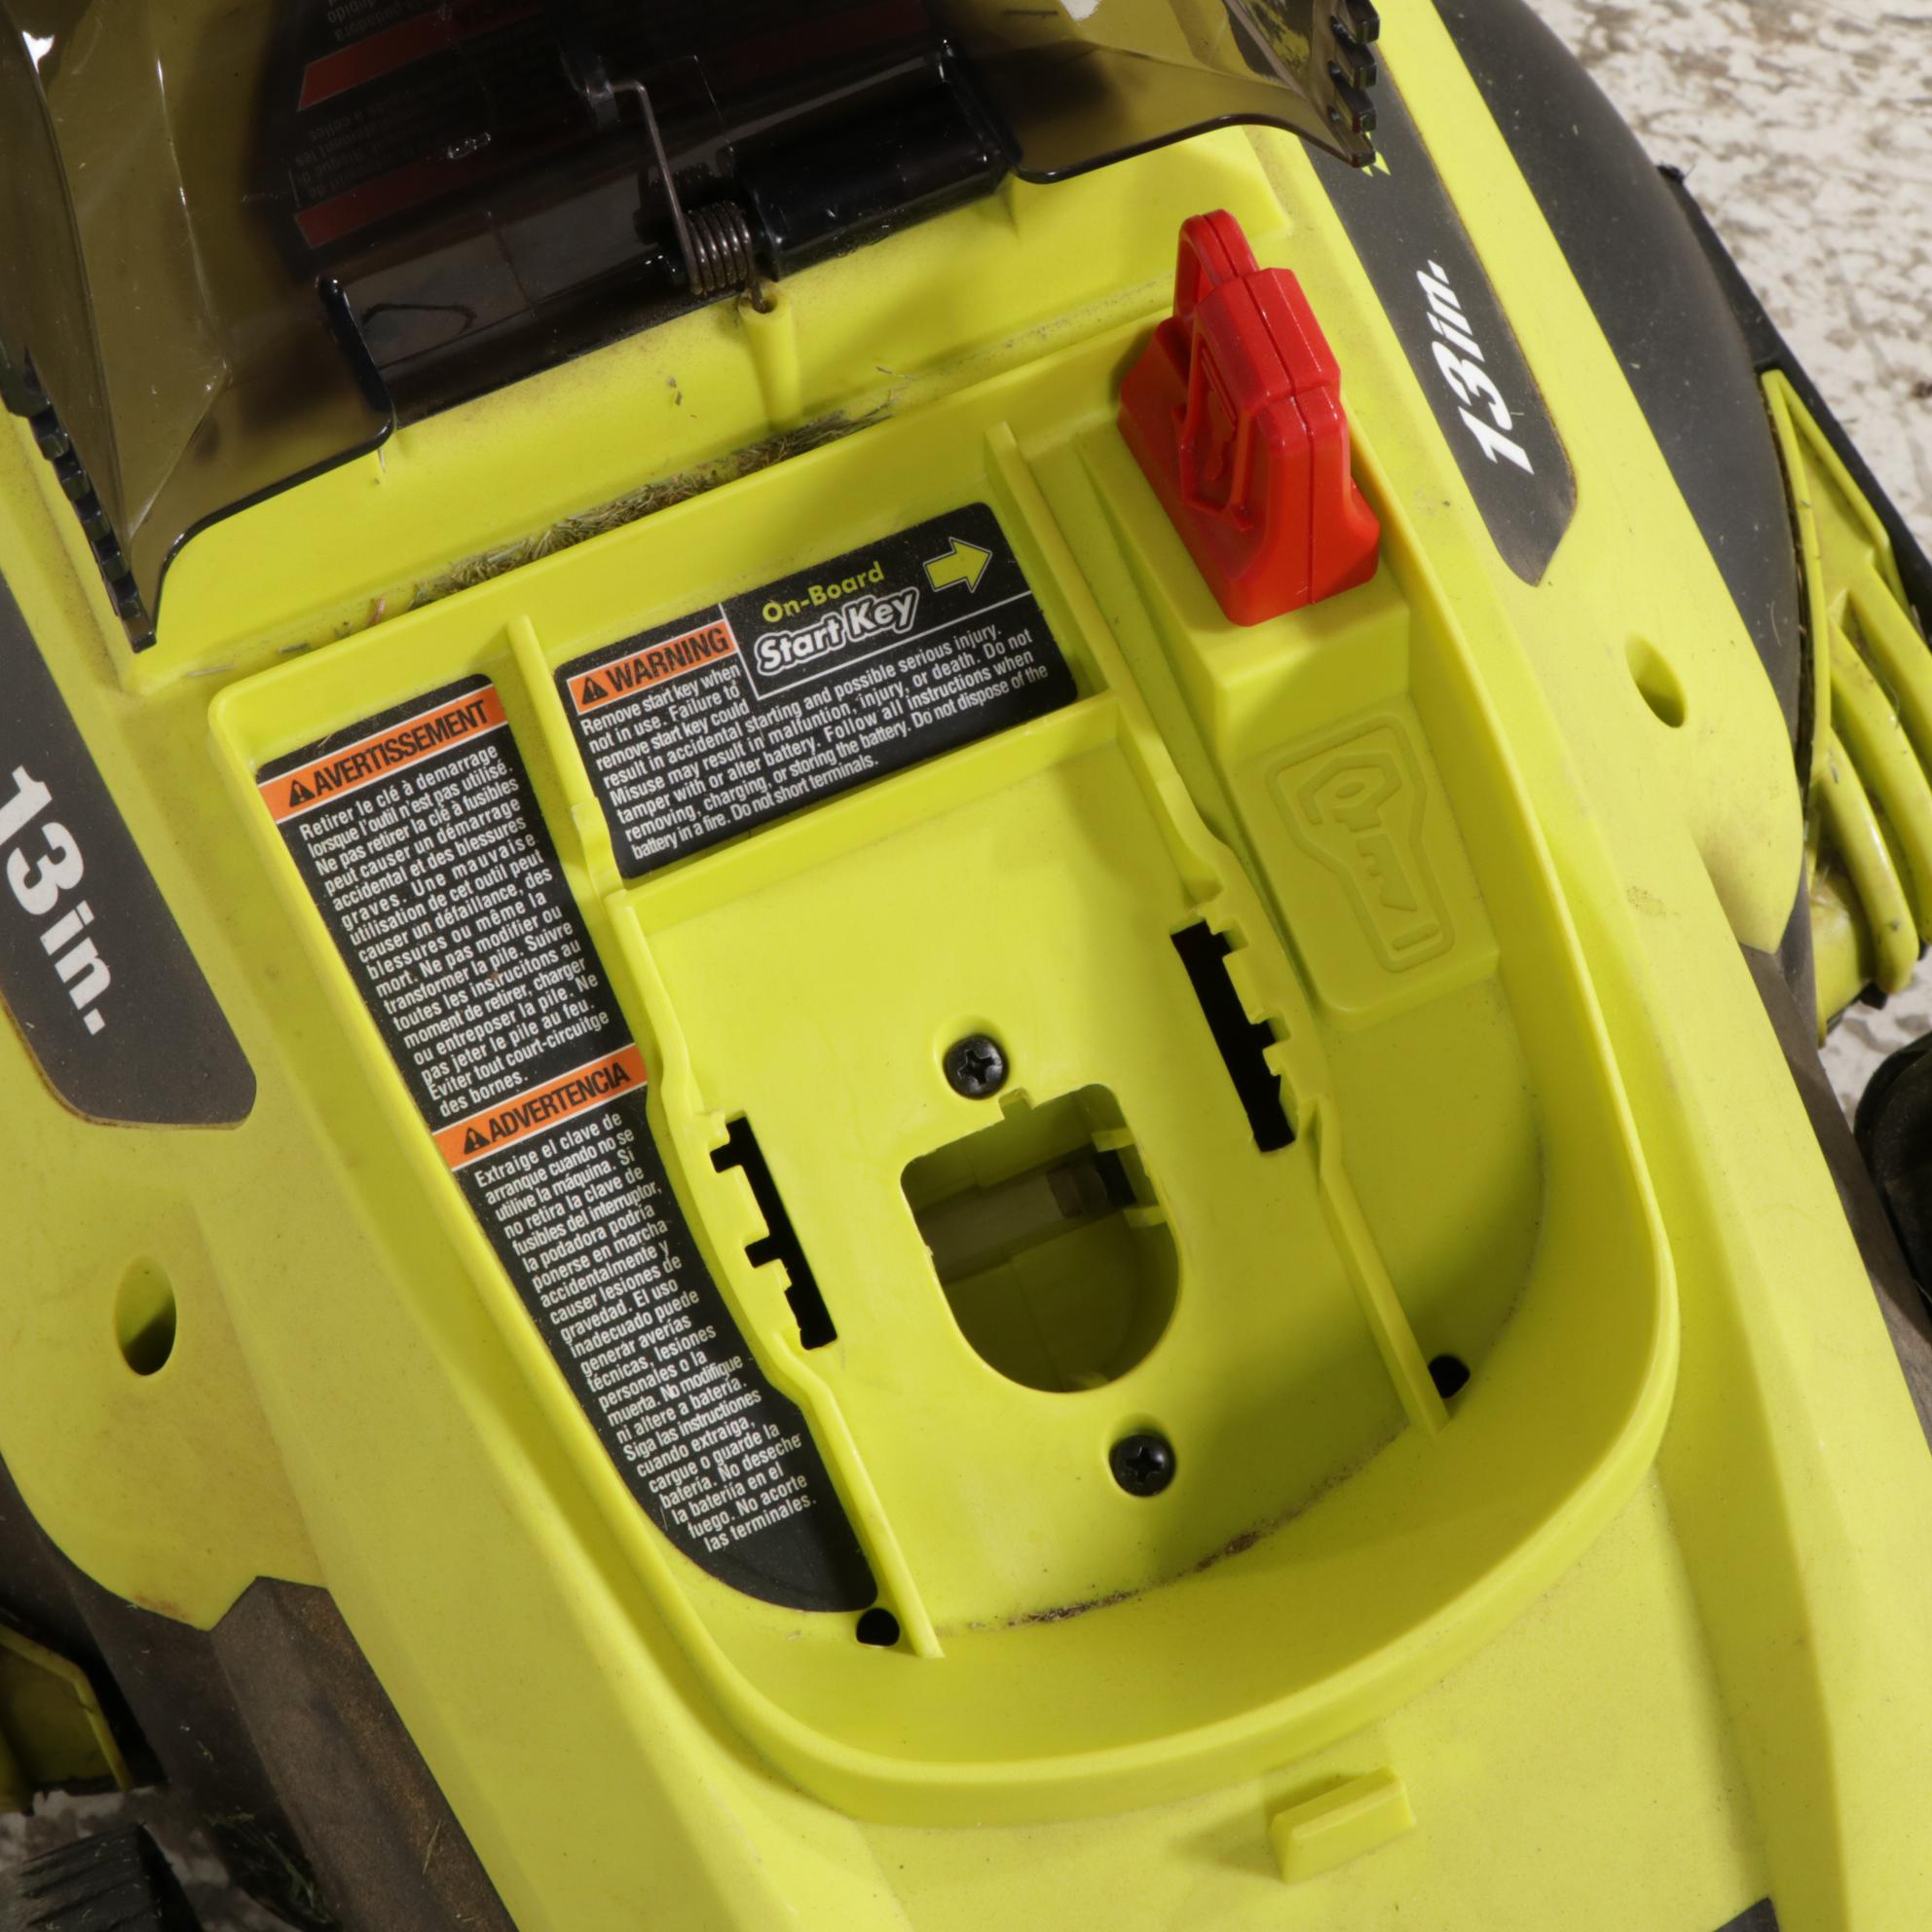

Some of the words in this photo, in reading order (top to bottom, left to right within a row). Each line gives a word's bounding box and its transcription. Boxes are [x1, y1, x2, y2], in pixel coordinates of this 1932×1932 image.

[762, 562, 884, 622] On-Board
[605, 627, 729, 692] WARNING
[759, 613, 845, 670] Start
[848, 591, 914, 636] Key
[579, 703, 642, 736] Remove
[642, 687, 675, 713] start
[672, 680, 699, 702] key
[699, 664, 741, 689] when
[588, 731, 615, 754] not
[614, 727, 632, 743] in
[633, 716, 667, 736] use.
[668, 691, 723, 722] Failure
[723, 681, 740, 700] to
[595, 741, 650, 771] remove
[650, 725, 684, 750] start
[681, 717, 709, 742] key
[710, 698, 750, 726] could
[603, 760, 648, 790] result
[648, 756, 665, 771] in
[666, 721, 743, 764] accidental
[744, 701, 802, 739] starting
[803, 687, 833, 710] and
[834, 664, 897, 702] possible
[898, 642, 952, 673] serious
[953, 624, 1001, 655] injury.
[609, 776, 665, 807] Misuse
[667, 762, 700, 785] may
[702, 740, 747, 770] result
[747, 731, 765, 753] in
[767, 699, 857, 745] malfuntion,
[857, 681, 910, 709] injury,
[911, 672, 928, 687] or
[931, 647, 981, 680] death.
[983, 640, 1005, 659] Do
[1008, 629, 1032, 650] not
[616, 794, 673, 824] tamper
[672, 777, 707, 802] with
[708, 772, 724, 789] or
[726, 758, 762, 781] alter
[762, 736, 821, 766] battery.
[823, 712, 877, 743] Follow
[878, 698, 904, 721] all
[905, 667, 992, 710] instructions
[992, 650, 1034, 675] when
[314, 699, 488, 797] AVERTISSEMENT
[625, 804, 704, 847] removing,
[703, 776, 772, 817] charging,
[772, 767, 788, 784] or
[789, 749, 839, 780] storing
[836, 740, 860, 759] the
[859, 721, 911, 749] battery.
[910, 708, 933, 728] Do
[933, 698, 957, 720] not
[957, 681, 1010, 711] dispose
[1011, 671, 1023, 688] of
[1024, 665, 1047, 682] the
[299, 807, 354, 841] Retirer
[355, 800, 374, 816] le
[376, 785, 400, 808] clé
[401, 780, 414, 797] à
[416, 745, 502, 795] demarrage
[631, 832, 678, 860] battery
[677, 826, 693, 841] in
[692, 822, 704, 836] a
[702, 813, 731, 832] fire.
[729, 799, 752, 821] Do
[752, 791, 775, 812] not
[773, 778, 810, 803] short
[808, 755, 878, 790] terminals.
[324, 867, 359, 897] peut
[359, 846, 411, 878] causer
[413, 836, 434, 854] un
[436, 799, 520, 844] démarrage
[330, 866, 408, 911] accidental
[409, 858, 427, 877] et
[427, 848, 455, 870] des
[454, 816, 526, 857] blessures
[341, 894, 407, 932] graves.
[410, 873, 446, 897] Une
[451, 834, 536, 879] mauvaise
[348, 903, 427, 946] utilisation
[427, 894, 448, 911] de
[449, 879, 474, 902] cet
[474, 863, 508, 891] outil
[509, 849, 544, 878] peut
[358, 931, 409, 963] causer
[411, 921, 433, 940] un
[434, 876, 524, 930] défaillance,
[525, 868, 553, 889] des
[366, 936, 448, 981] blessures
[451, 925, 472, 944] ou
[475, 901, 526, 933] même
[528, 892, 547, 909] la
[384, 967, 469, 1015] transformer
[470, 960, 489, 976] la
[489, 947, 527, 972] pile.
[524, 922, 573, 951] Suivre
[413, 1048, 434, 1065] ou
[436, 1010, 522, 1057] entreposer
[517, 1002, 537, 1019] la
[538, 987, 574, 1014] pile.
[573, 975, 598, 992] Ne
[439, 1096, 468, 1117] des
[468, 1071, 528, 1104] bornes.
[489, 1061, 631, 1143] ADVERTENCIA
[474, 1150, 539, 1188] Extraige
[541, 1138, 558, 1158] el
[559, 1123, 601, 1150] clave
[602, 1113, 622, 1131] de
[503, 1221, 524, 1239] no
[525, 1203, 566, 1230] retira
[565, 1195, 583, 1210] la
[583, 1176, 623, 1203] clave
[624, 1167, 644, 1184] de
[512, 1223, 567, 1256] fusibles
[566, 1209, 590, 1232] del
[587, 1181, 661, 1222] interruptor,
[522, 1257, 539, 1273] la
[539, 1226, 608, 1269] podadora
[608, 1205, 655, 1238] podría
[532, 1255, 595, 1294] ponerse
[592, 1245, 613, 1263] en
[613, 1220, 668, 1253] marcha
[538, 1245, 658, 1308] accidentalmente
[658, 1240, 669, 1259] y
[549, 1293, 598, 1324] causer
[598, 1265, 661, 1302] lesiones
[662, 1256, 682, 1274] de
[560, 1298, 633, 1345] gravedad.
[632, 1288, 650, 1308] El
[650, 1280, 679, 1300] uso
[567, 1312, 653, 1358] inadecuado
[653, 1290, 699, 1323] puede
[598, 1364, 678, 1413] personales
[679, 1358, 690, 1372] o
[689, 1351, 708, 1366] la
[636, 1444, 689, 1477] cuando
[690, 1417, 756, 1452] extraiga,
[658, 1476, 718, 1509] batería.
[717, 1464, 741, 1482] No
[741, 1434, 801, 1471] deseche
[687, 1510, 735, 1540] fuego.
[735, 1498, 759, 1516] No
[760, 1475, 807, 1505] acorte
[703, 1529, 729, 1552] las
[729, 1495, 816, 1541] terminales.
